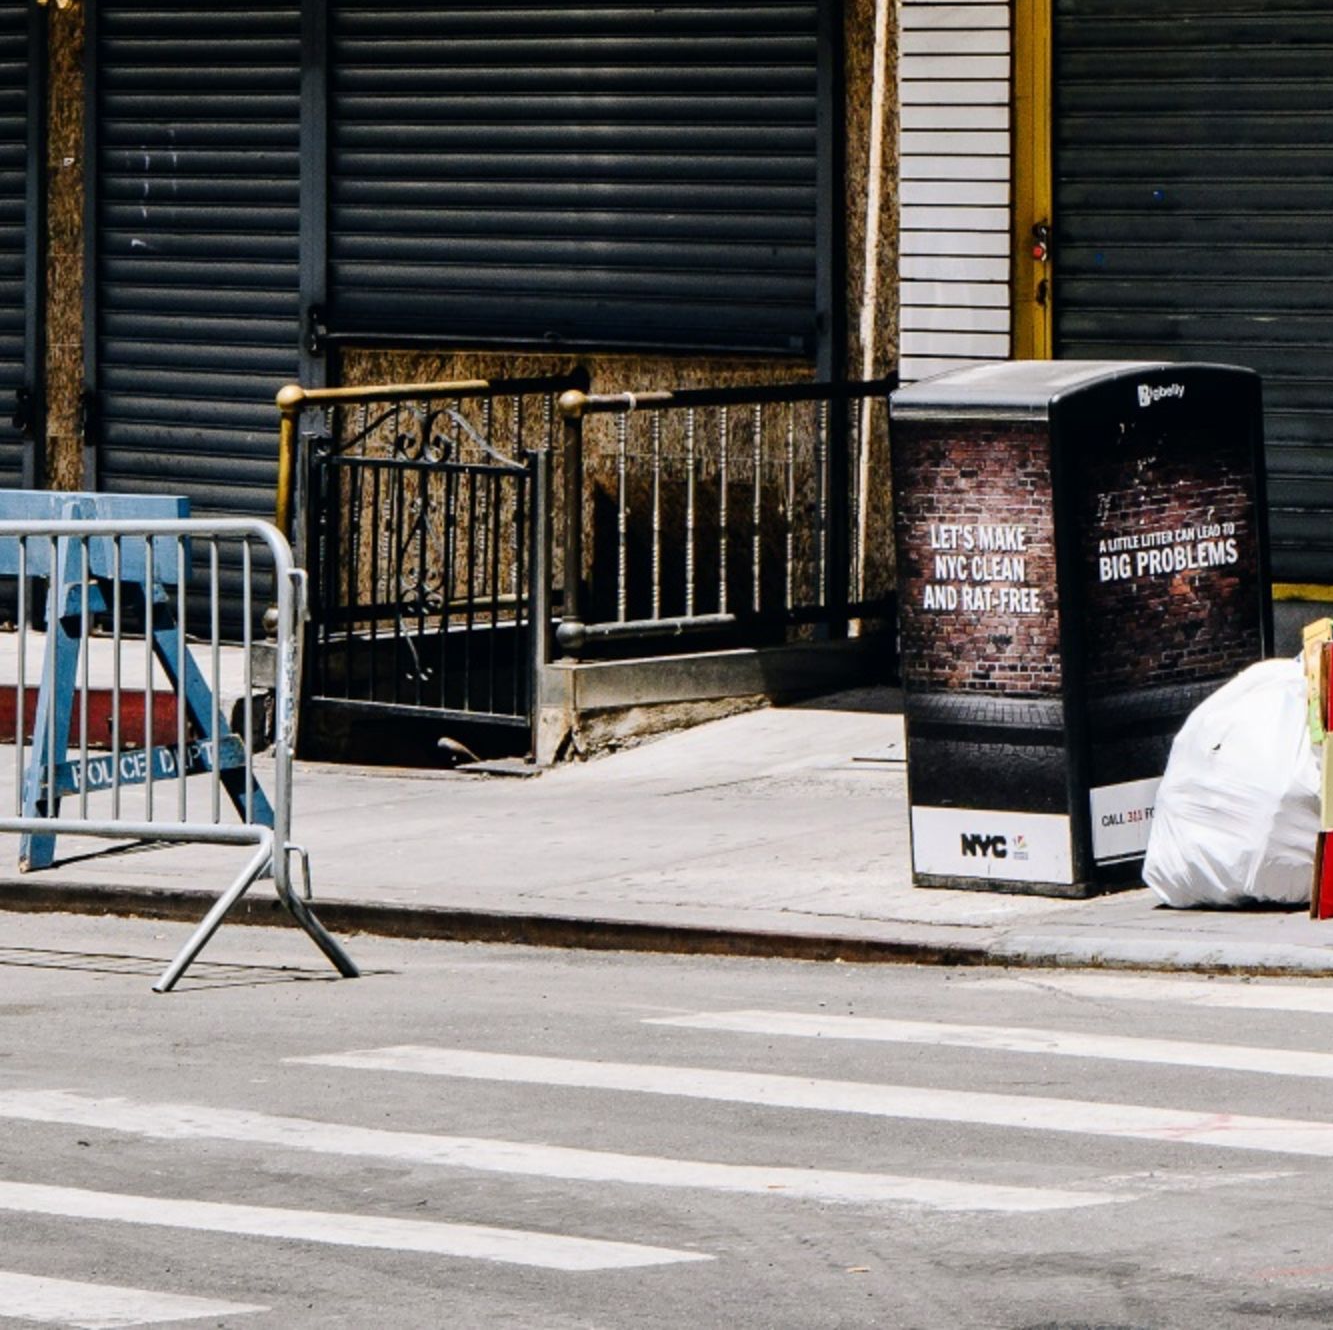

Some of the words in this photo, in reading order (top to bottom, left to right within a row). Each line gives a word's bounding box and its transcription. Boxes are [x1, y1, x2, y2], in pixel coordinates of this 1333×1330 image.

[931, 524, 974, 550] LET'S
[980, 526, 1026, 551] MAKE
[1100, 540, 1106, 553] A
[1108, 535, 1139, 551] LITTLE
[1141, 531, 1173, 547] LITTER
[1175, 529, 1195, 541] CAN
[1197, 524, 1220, 538] LEAD
[1223, 522, 1235, 536] TO
[935, 555, 967, 580] NYC
[971, 555, 1024, 581] CLEAN
[1100, 553, 1132, 582] BIG
[1136, 538, 1238, 576] PROBLEMS
[924, 585, 957, 610] AND
[962, 585, 1040, 612] RAT-FREE
[72, 753, 146, 788] POLCE
[961, 833, 1007, 858] NYC
